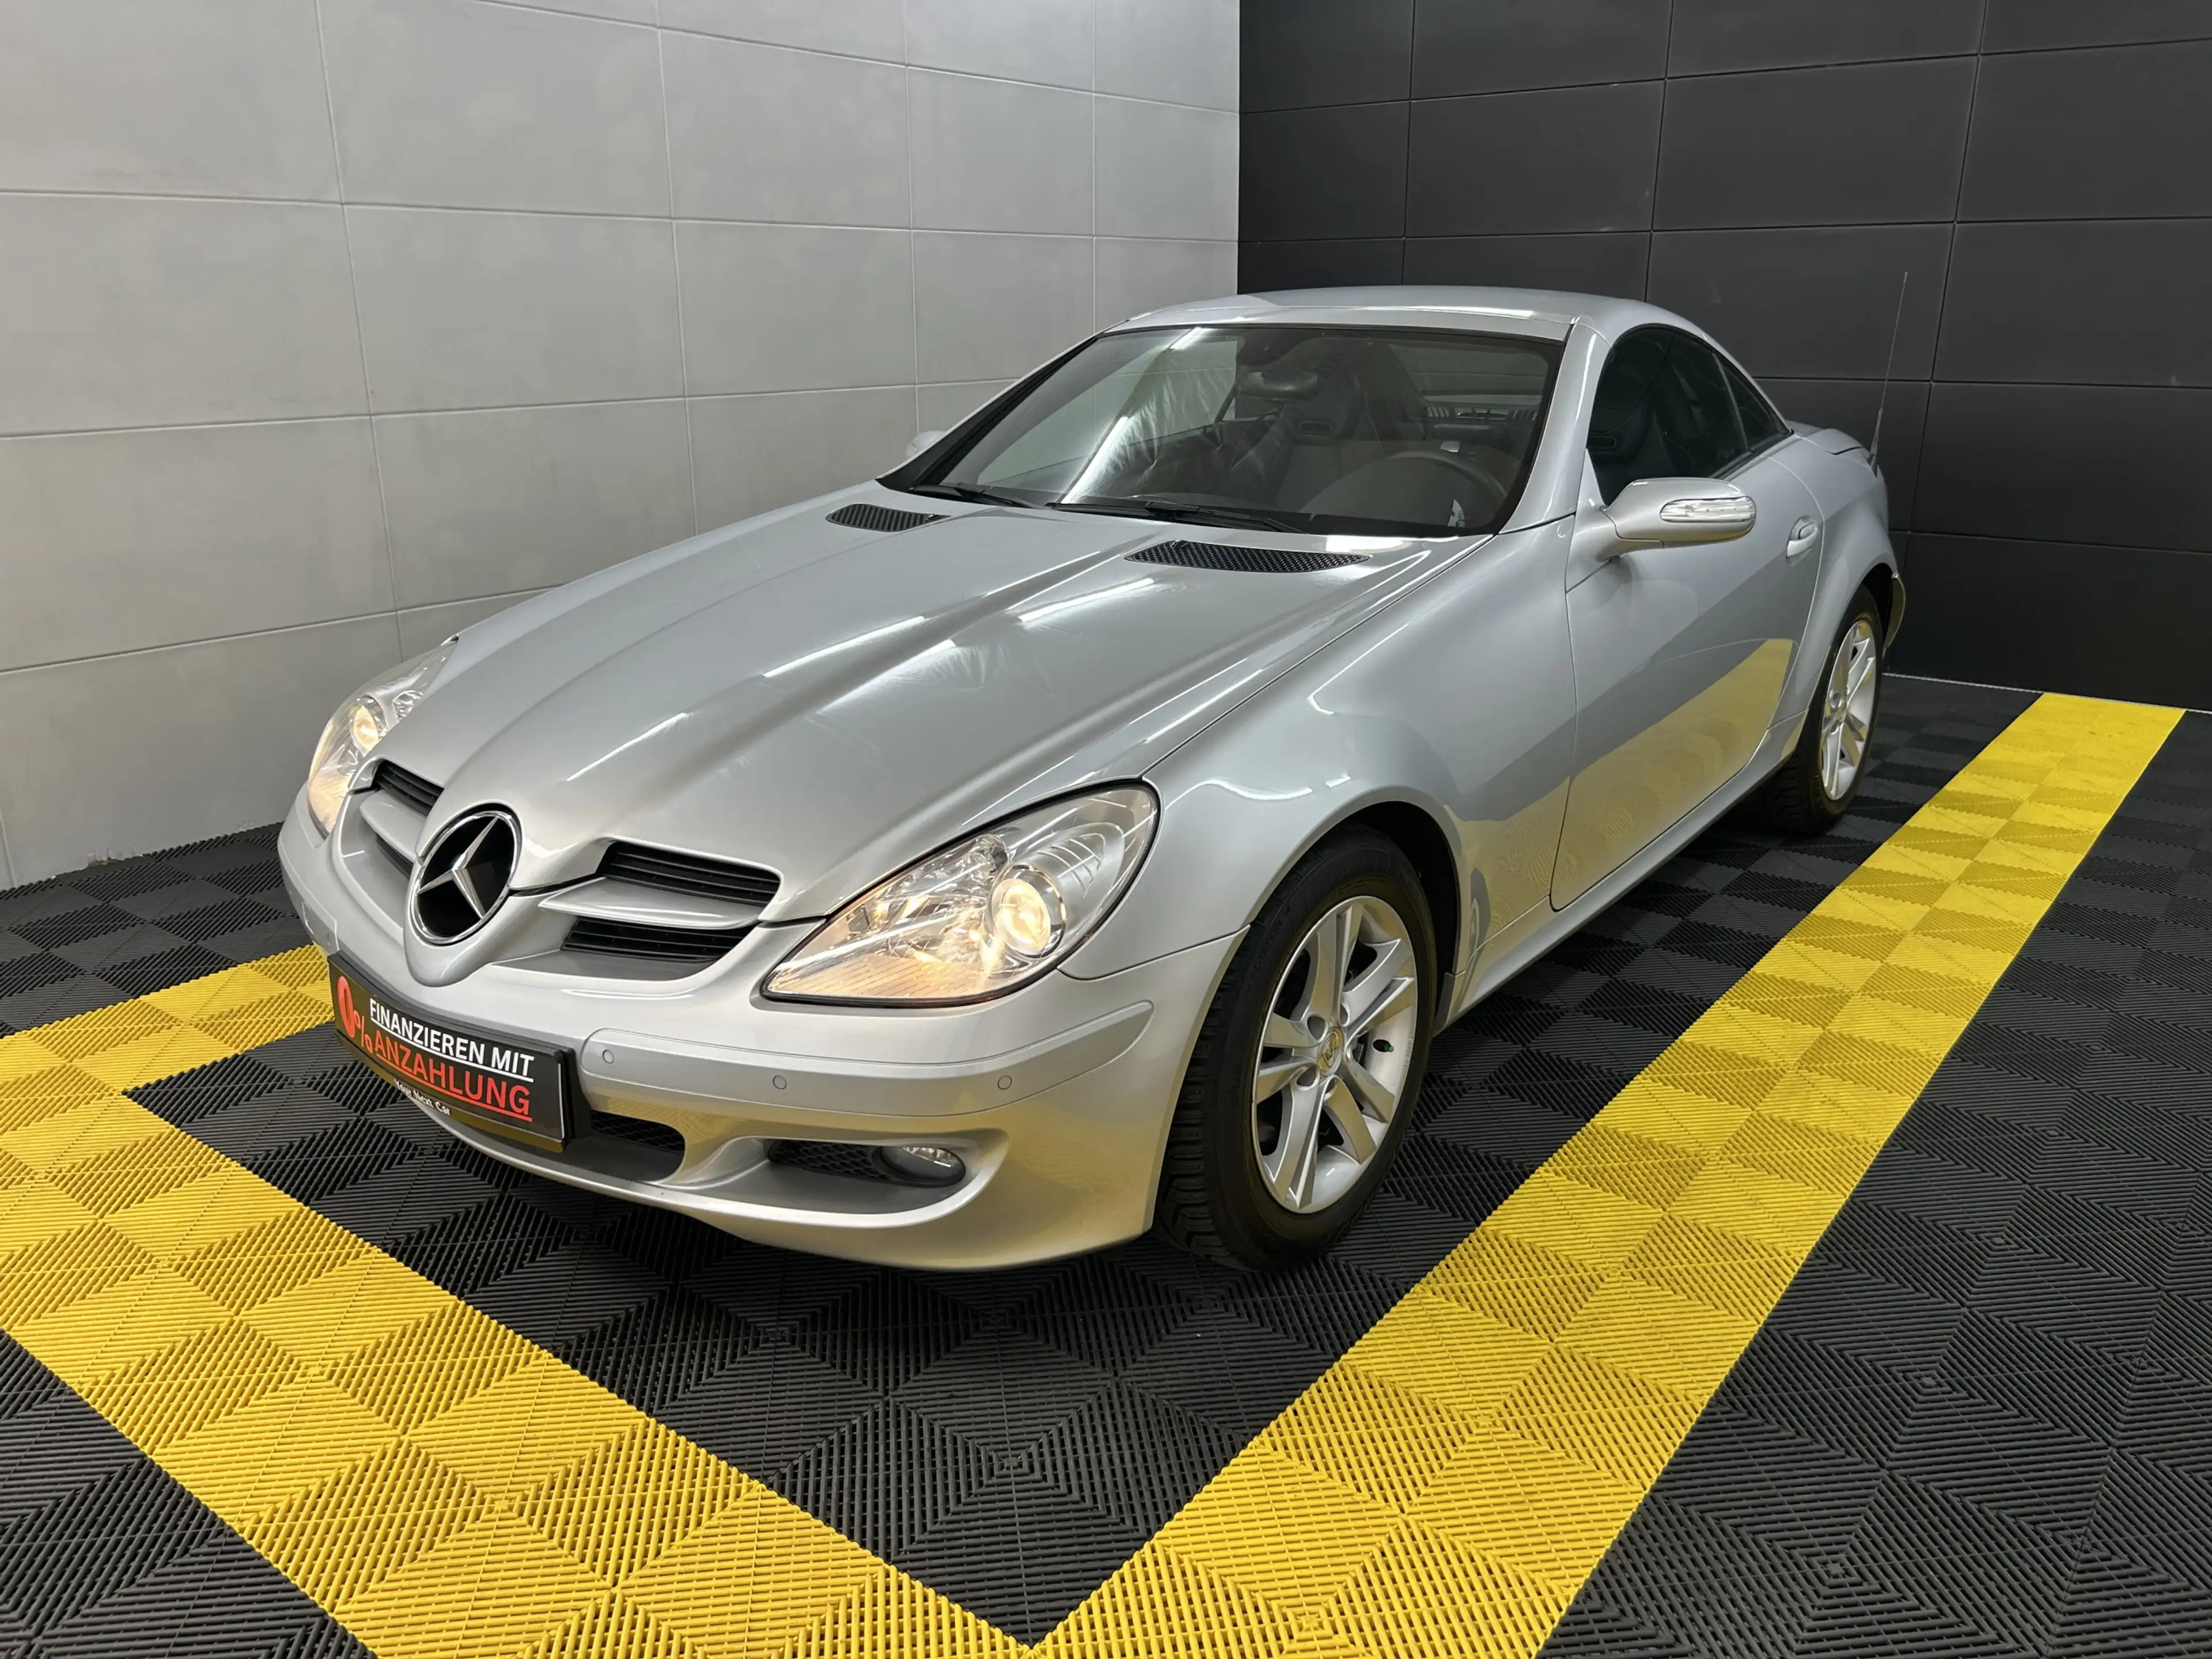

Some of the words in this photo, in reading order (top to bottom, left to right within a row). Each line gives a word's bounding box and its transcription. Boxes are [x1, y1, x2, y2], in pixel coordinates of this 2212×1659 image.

[337, 975, 373, 1054] 0%
[375, 1033, 530, 1115] ANZAHLUNG
[369, 998, 484, 1065] FINANZIEREN
[492, 1047, 534, 1076] MIT
[413, 1090, 434, 1108] Next
[435, 1101, 450, 1115] Car
